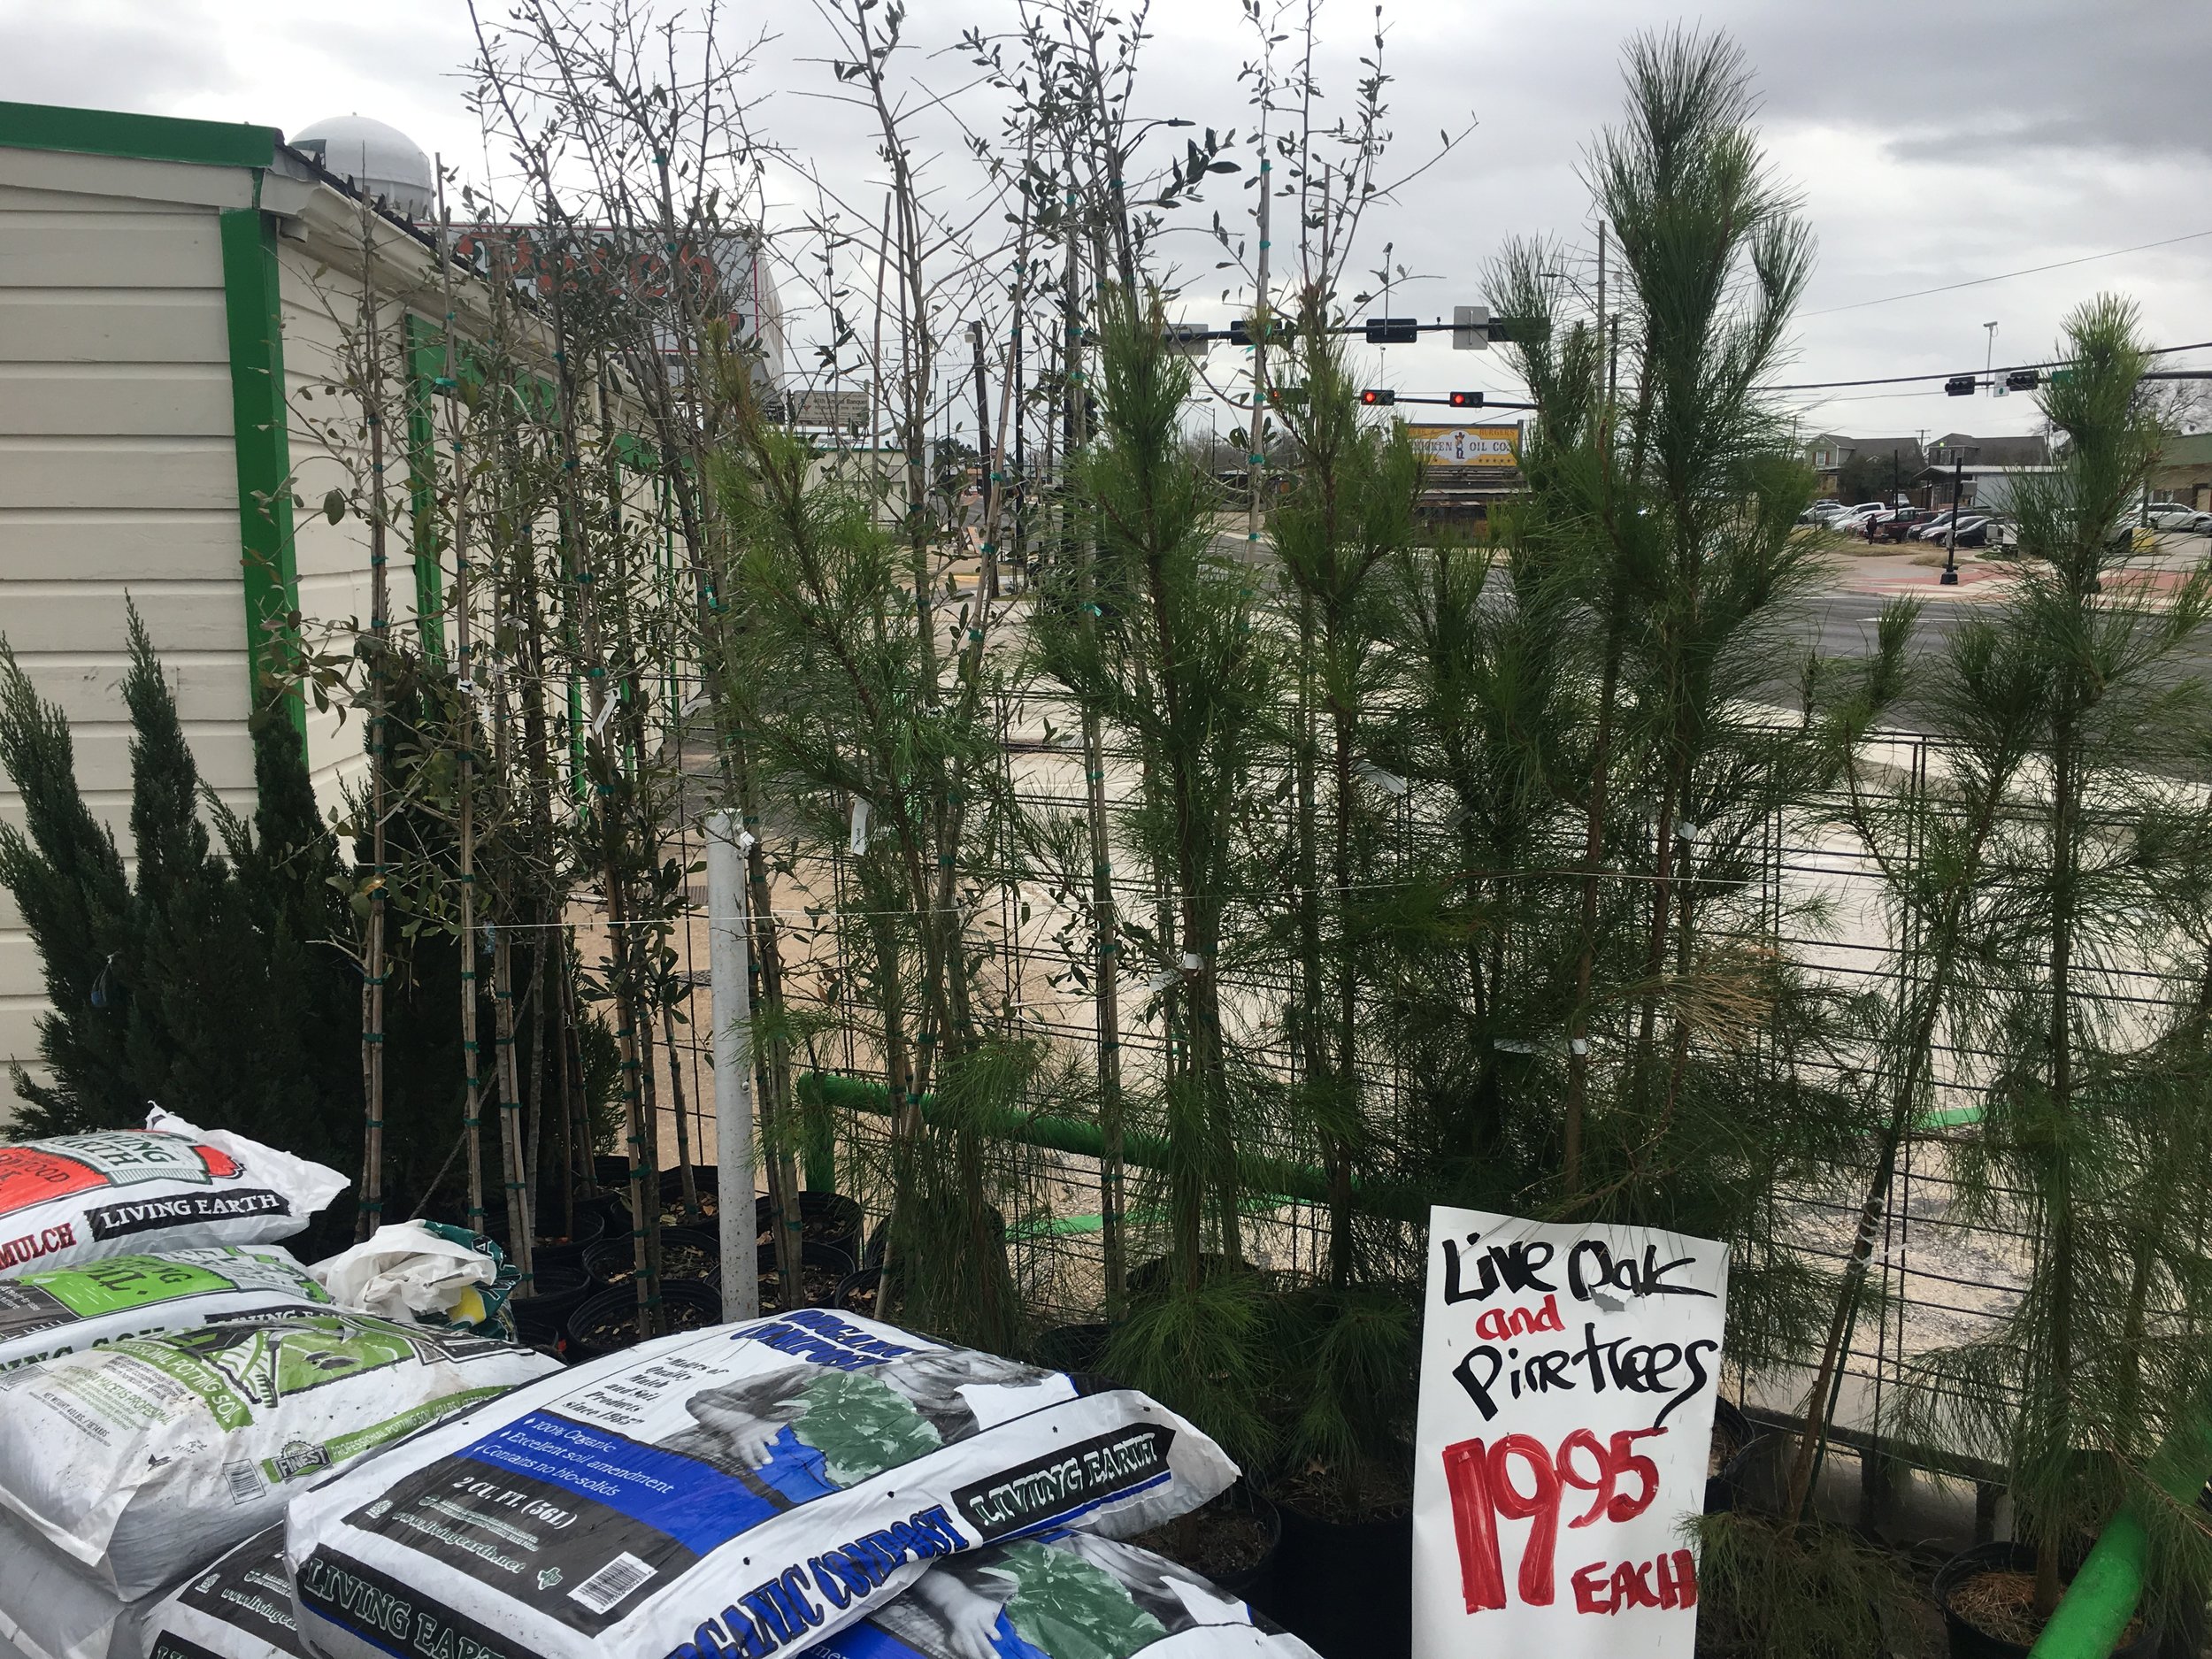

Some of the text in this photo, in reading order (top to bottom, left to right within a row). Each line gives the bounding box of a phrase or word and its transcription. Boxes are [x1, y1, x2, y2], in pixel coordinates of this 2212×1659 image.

[1470, 442, 1486, 451] OIL
[100, 1194, 280, 1228] LIVING EARTH
[0, 1223, 77, 1271] MULCH
[1442, 1233, 1717, 1306] Live Oak
[1476, 1294, 1565, 1341] and
[731, 1322, 893, 1371] COMPOST
[167, 1358, 221, 1392] POTTING
[211, 1394, 242, 1423] SOIL
[603, 1384, 663, 1402] and Soil
[625, 1374, 670, 1388] Mulch
[646, 1366, 695, 1381] Quality
[562, 1401, 601, 1416] since
[584, 1391, 644, 1413] Products
[331, 1428, 388, 1459] PROFESSIONAL
[387, 1416, 418, 1438] POTTING
[532, 1421, 617, 1453] 100% Organic
[280, 1447, 327, 1477] FINEST
[483, 1445, 620, 1497] Contains no bio-solids
[507, 1432, 675, 1494] Excellent soil amendment
[970, 1432, 1157, 1526] LIVING EARTH
[452, 1476, 474, 1488] 2
[495, 1490, 528, 1509] FT.
[520, 1499, 579, 1529] (56L)
[392, 1509, 526, 1574] www.livingearth.net
[807, 1505, 969, 1609] COMPOST
[1571, 1548, 1699, 1616] EACH
[304, 1558, 411, 1640] LIVING
[413, 1613, 506, 1659] EAR
